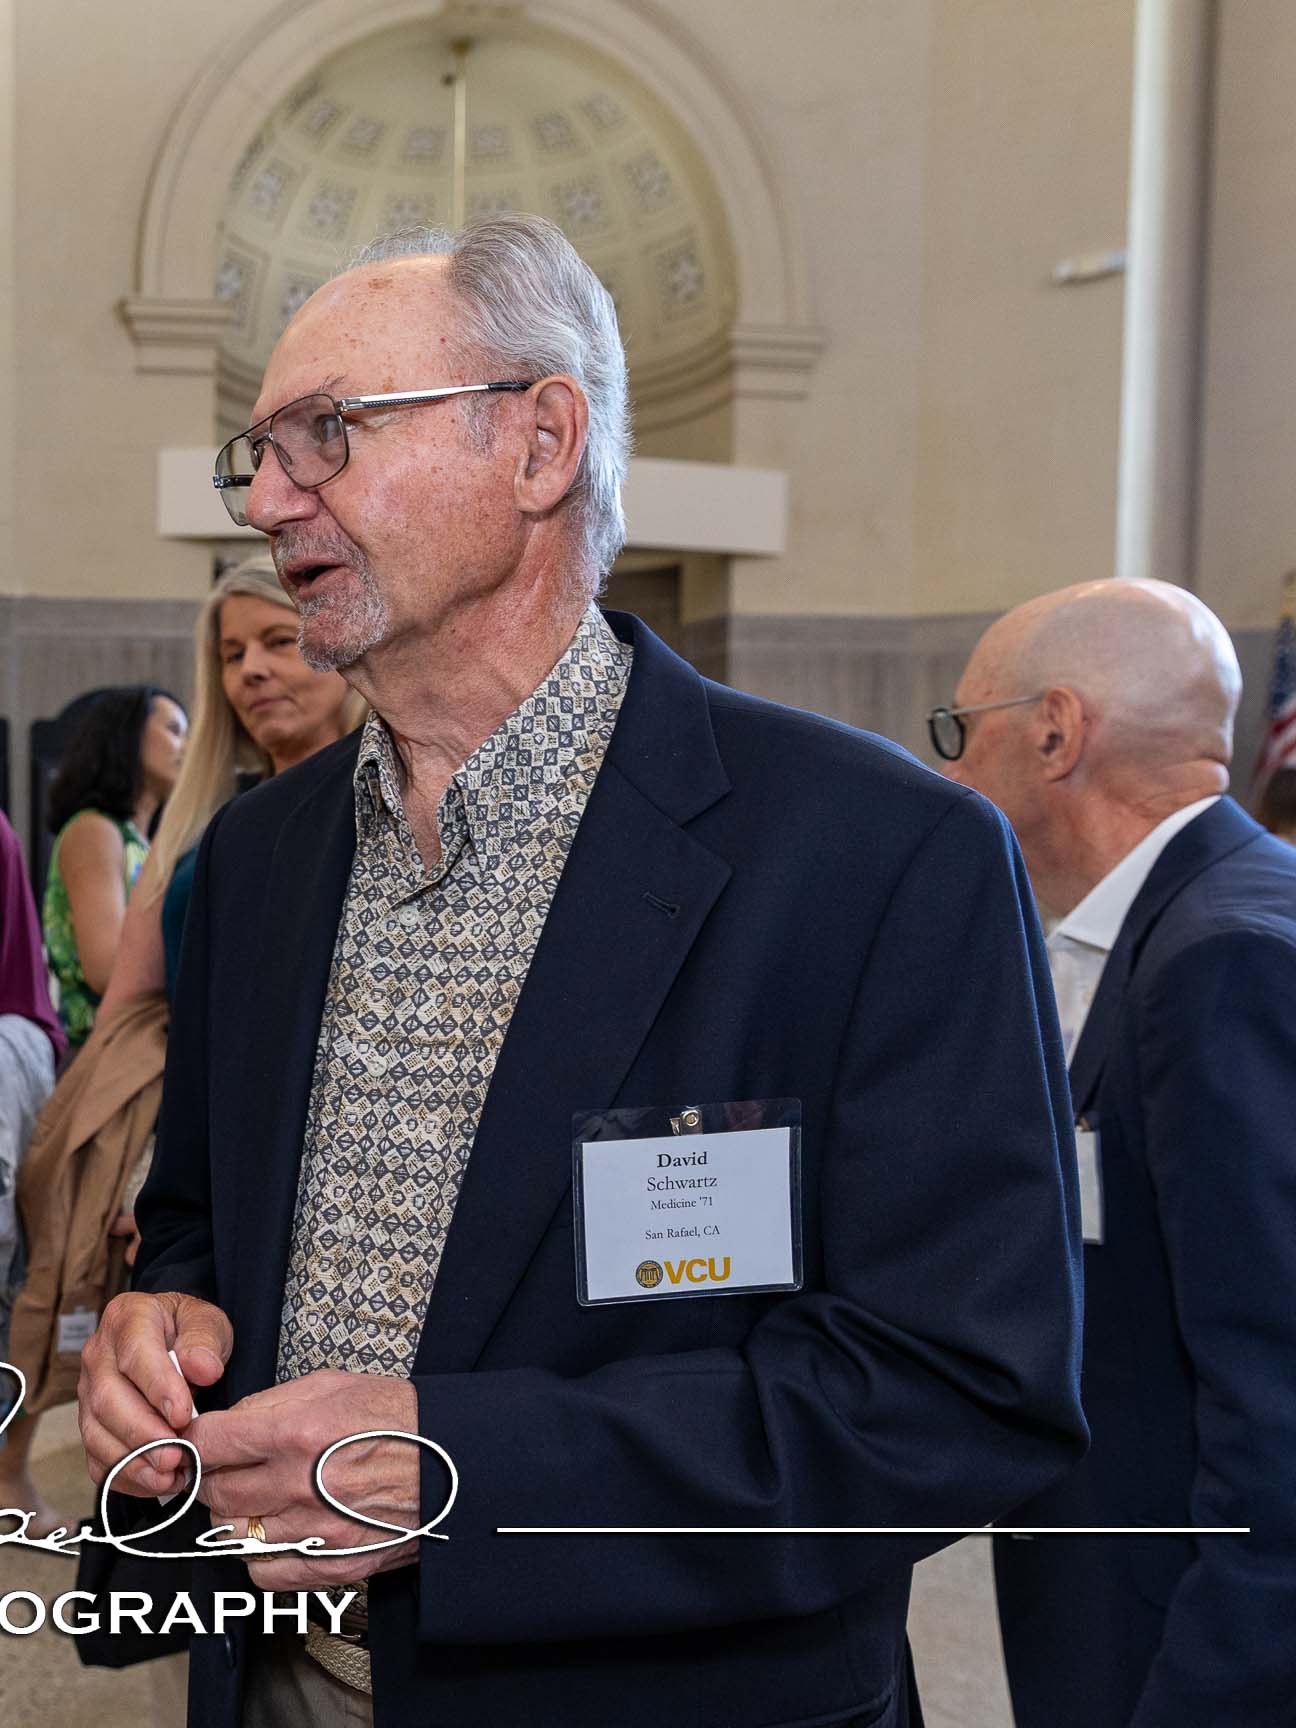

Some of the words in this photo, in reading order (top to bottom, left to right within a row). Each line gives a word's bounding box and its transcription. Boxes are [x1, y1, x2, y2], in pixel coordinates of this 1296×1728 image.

[656, 1151, 708, 1168] David
[646, 1175, 718, 1192] Schwartz
[650, 1198, 697, 1210] Medicine
[645, 1229, 664, 1240] San
[667, 1226, 701, 1239] Rafael,
[703, 1225, 720, 1236] CA
[664, 1256, 731, 1285] VCU
